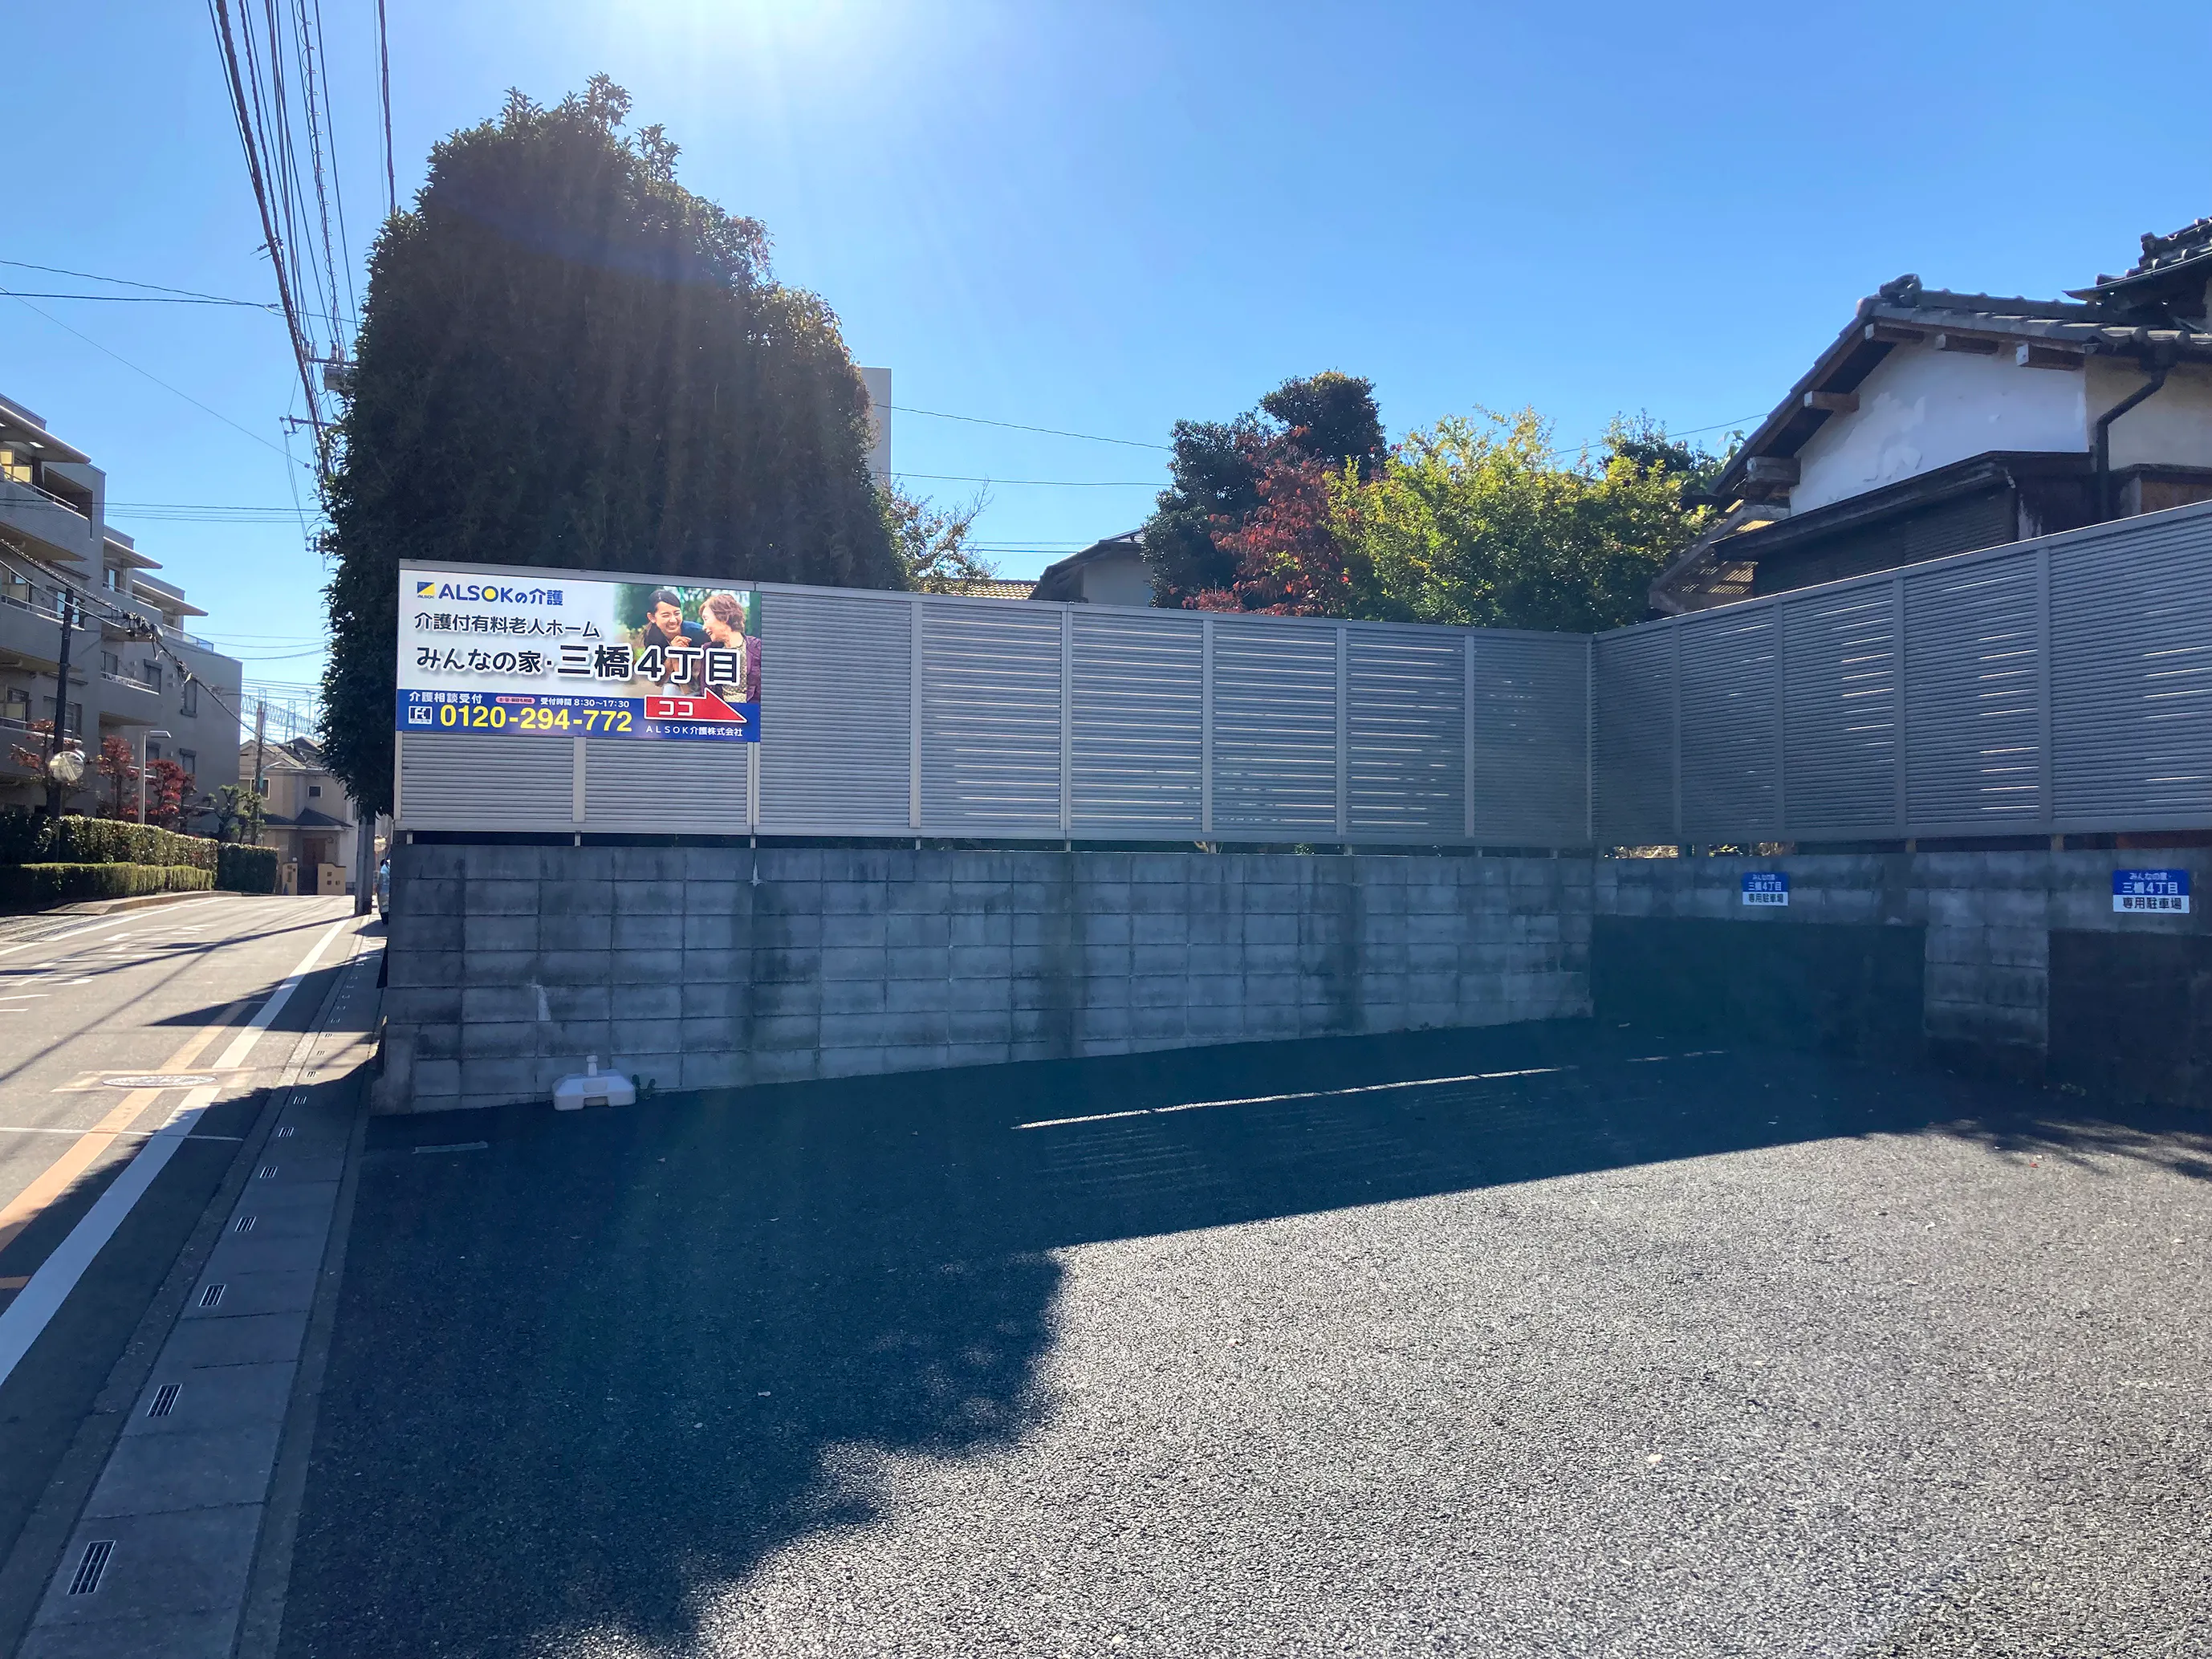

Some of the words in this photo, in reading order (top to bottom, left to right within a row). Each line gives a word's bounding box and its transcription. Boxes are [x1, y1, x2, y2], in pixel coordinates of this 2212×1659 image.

[438, 583, 563, 606] ALSOKの介護
[414, 612, 600, 638] 介護付有料老人ホーム
[409, 691, 483, 705] 介護相談受付
[540, 697, 572, 706] 受付時間
[440, 704, 632, 732] 0120-294-772
[658, 700, 693, 717] ココ
